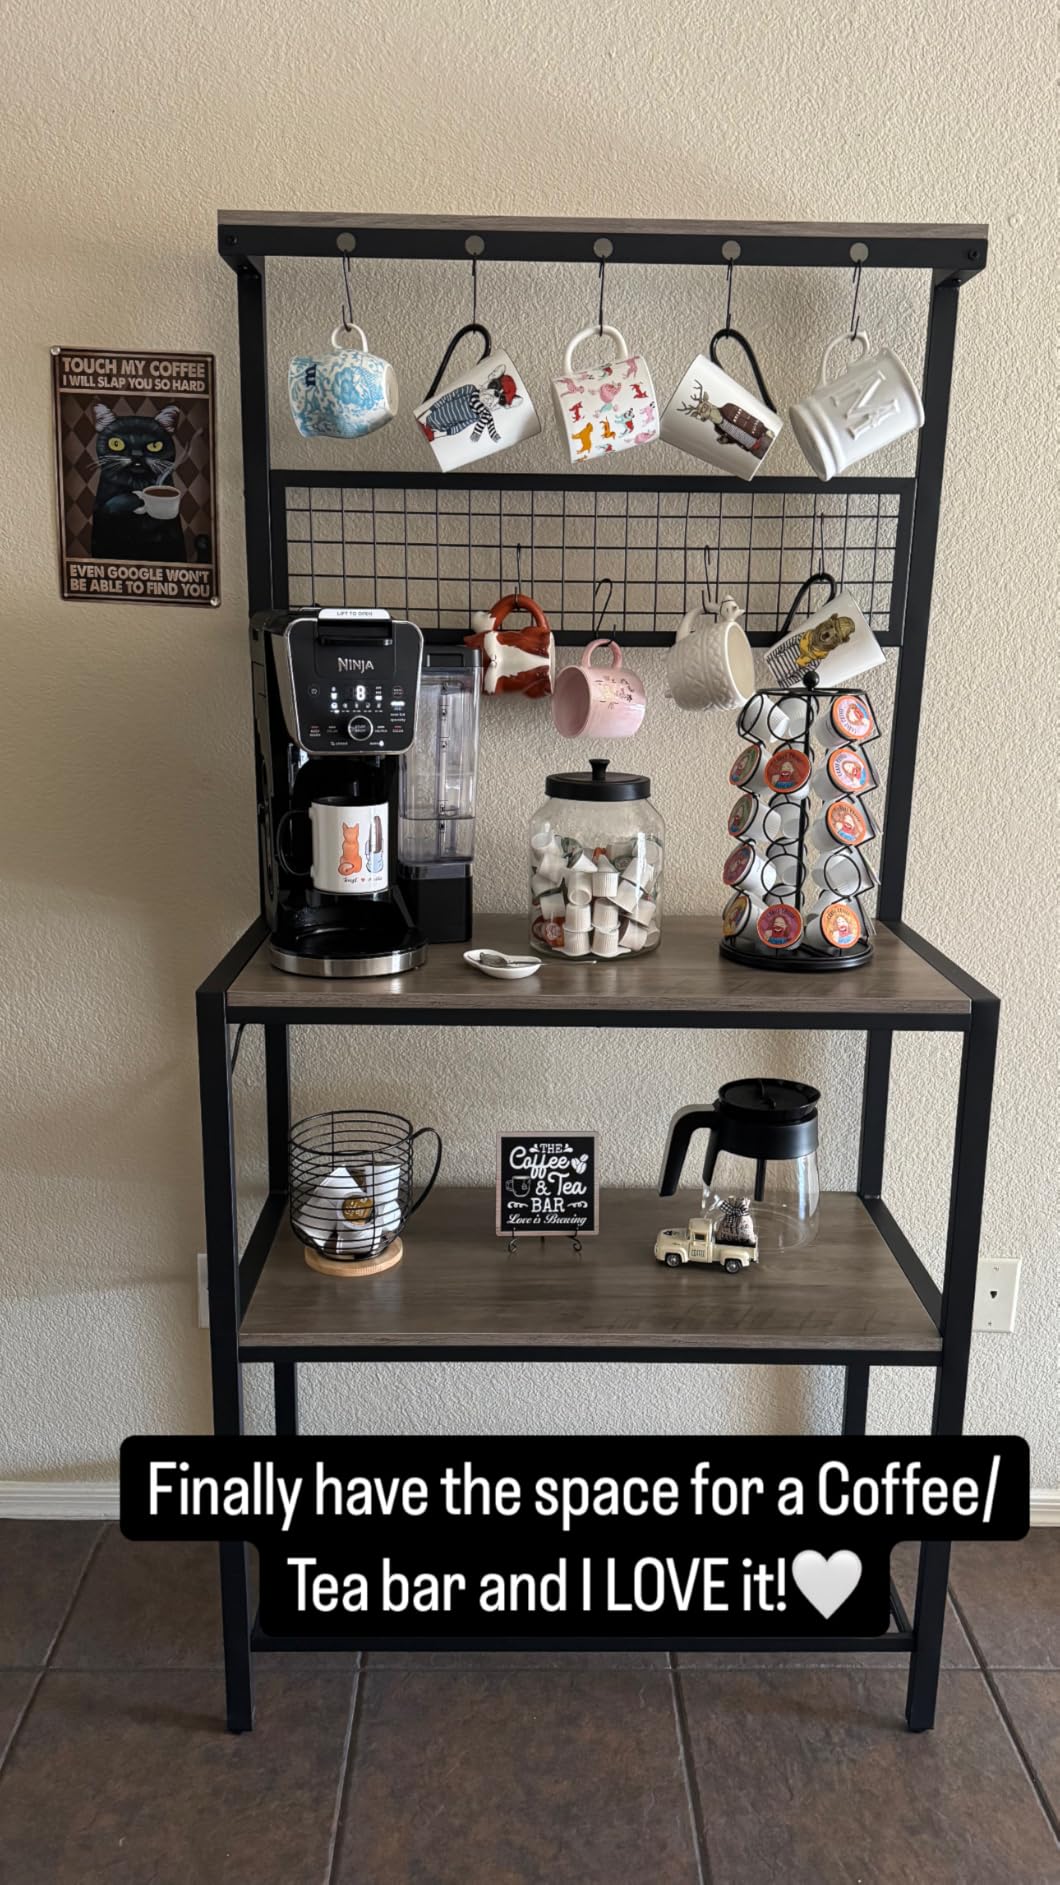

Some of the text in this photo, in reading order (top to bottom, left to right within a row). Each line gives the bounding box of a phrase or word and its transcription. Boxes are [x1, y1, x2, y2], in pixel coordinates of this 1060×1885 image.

[62, 357, 205, 378] TOUCH MY COFFEE
[63, 375, 205, 392] I WILL SLAP YOU SO HARD
[70, 565, 209, 582] EVEN GOOGLE WON'T
[70, 578, 210, 598] BE ABLE TO FIND YOU
[356, 685, 366, 701] 8
[540, 1143, 563, 1154] THE
[509, 1146, 571, 1179] Coffee
[536, 1171, 587, 1196] & Tea
[531, 1197, 565, 1213] BAR
[506, 1213, 533, 1224] Love
[533, 1213, 541, 1224] is
